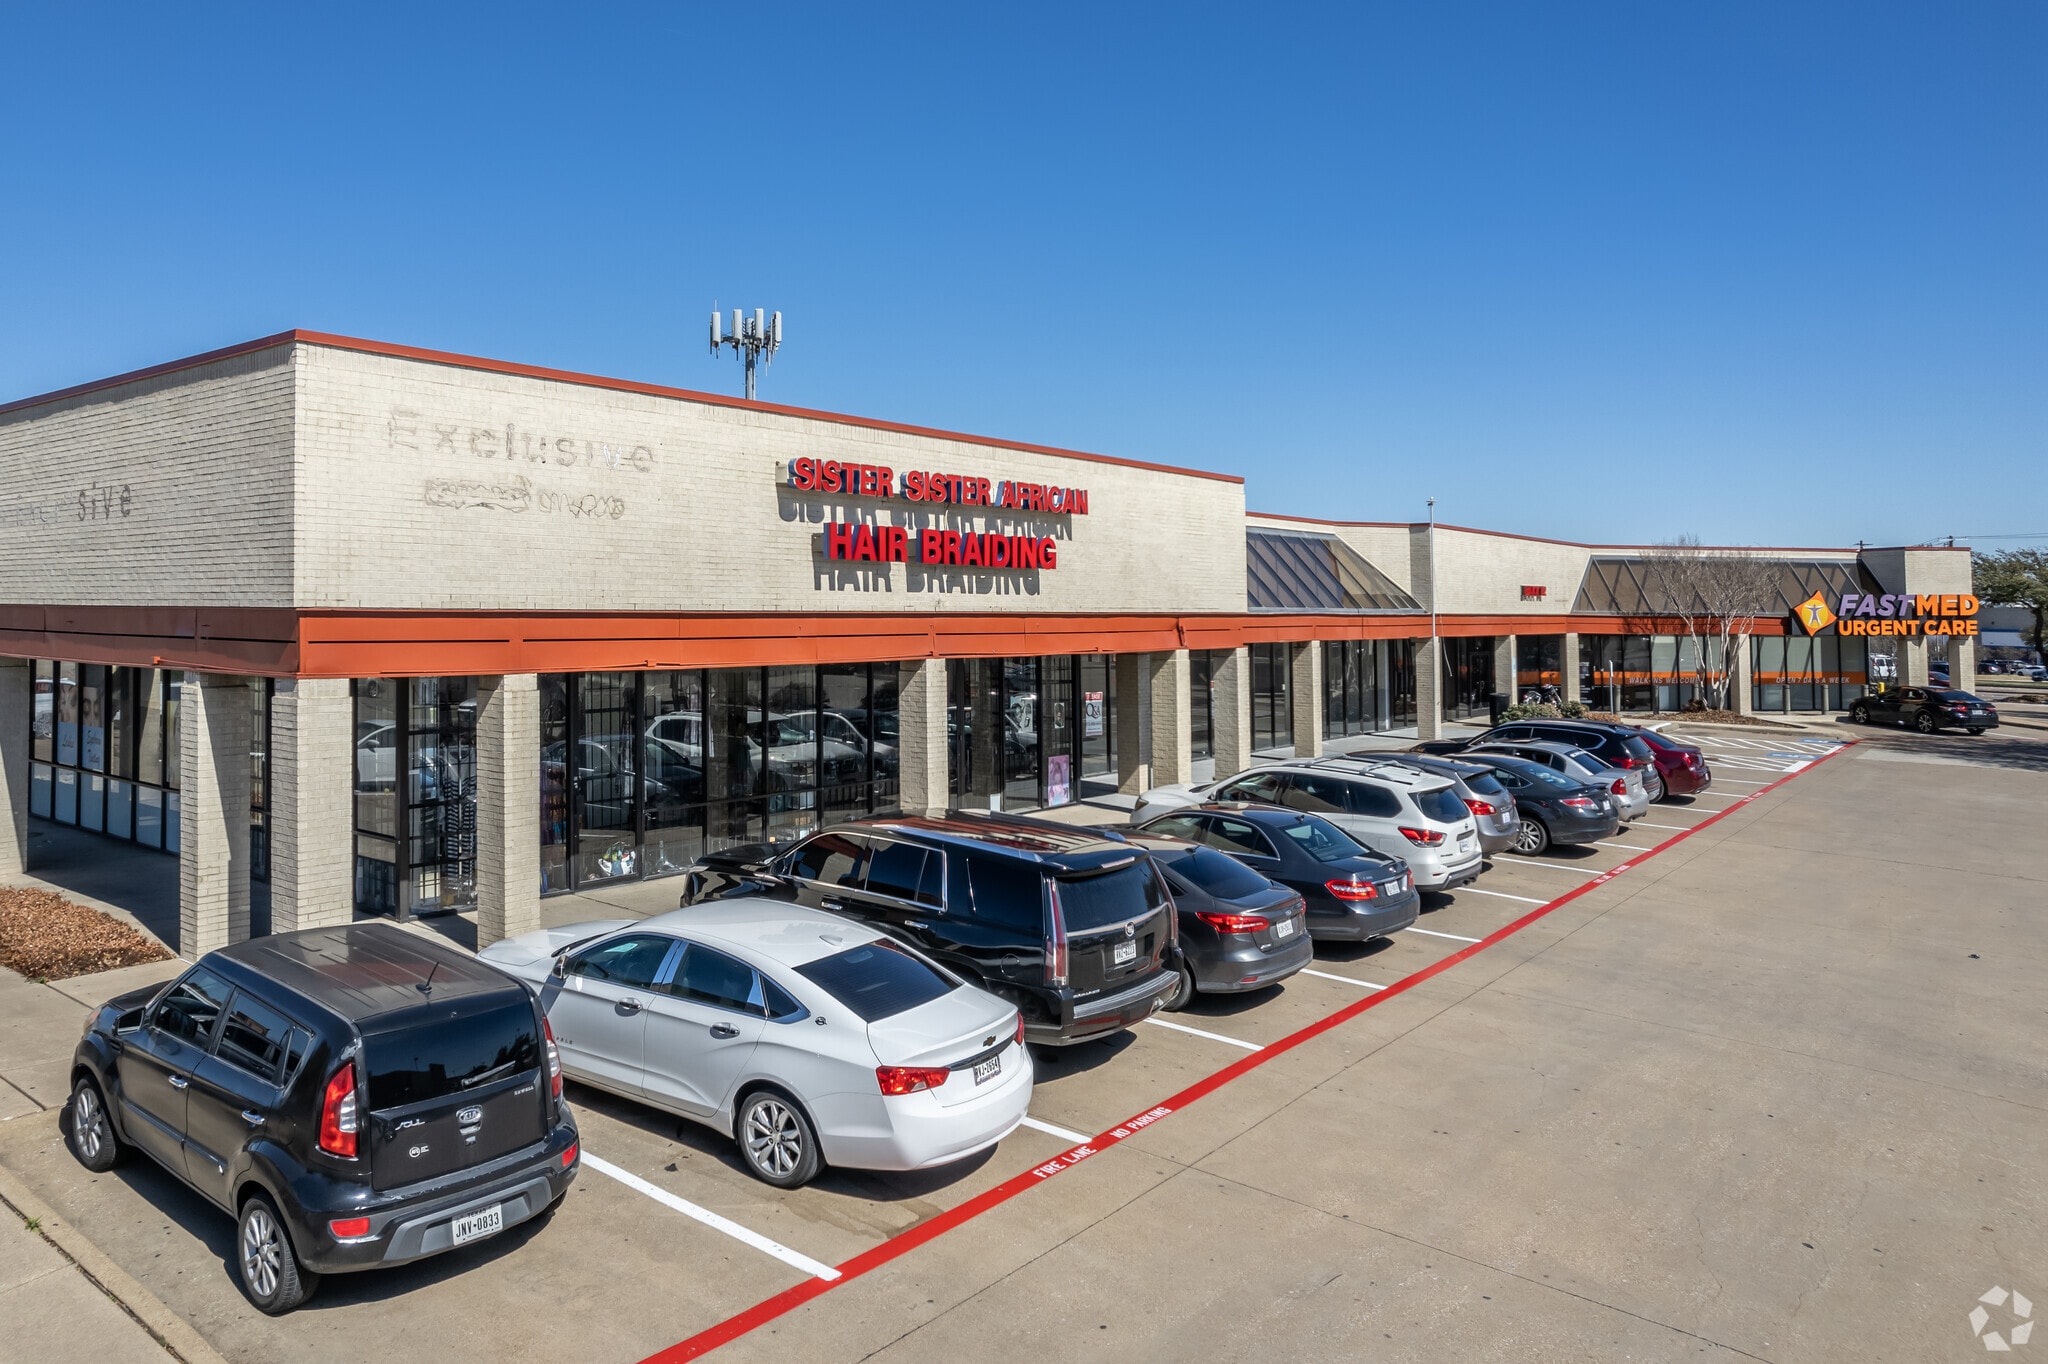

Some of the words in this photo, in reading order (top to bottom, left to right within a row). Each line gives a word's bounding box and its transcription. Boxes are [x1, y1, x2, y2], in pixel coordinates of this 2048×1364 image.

[788, 456, 894, 498] SISTER
[900, 470, 992, 506] SISTER
[996, 480, 1089, 515] AFRICAN
[826, 521, 909, 563] HAIR
[918, 528, 1057, 570] BRAIDING
[1838, 620, 1920, 636] URGENT
[1923, 620, 1979, 636] CARE
[1032, 1160, 1067, 1179] FIRE
[1062, 1145, 1097, 1164] LANE
[1109, 1128, 1132, 1139] NO
[1126, 1106, 1172, 1130] PARKING
